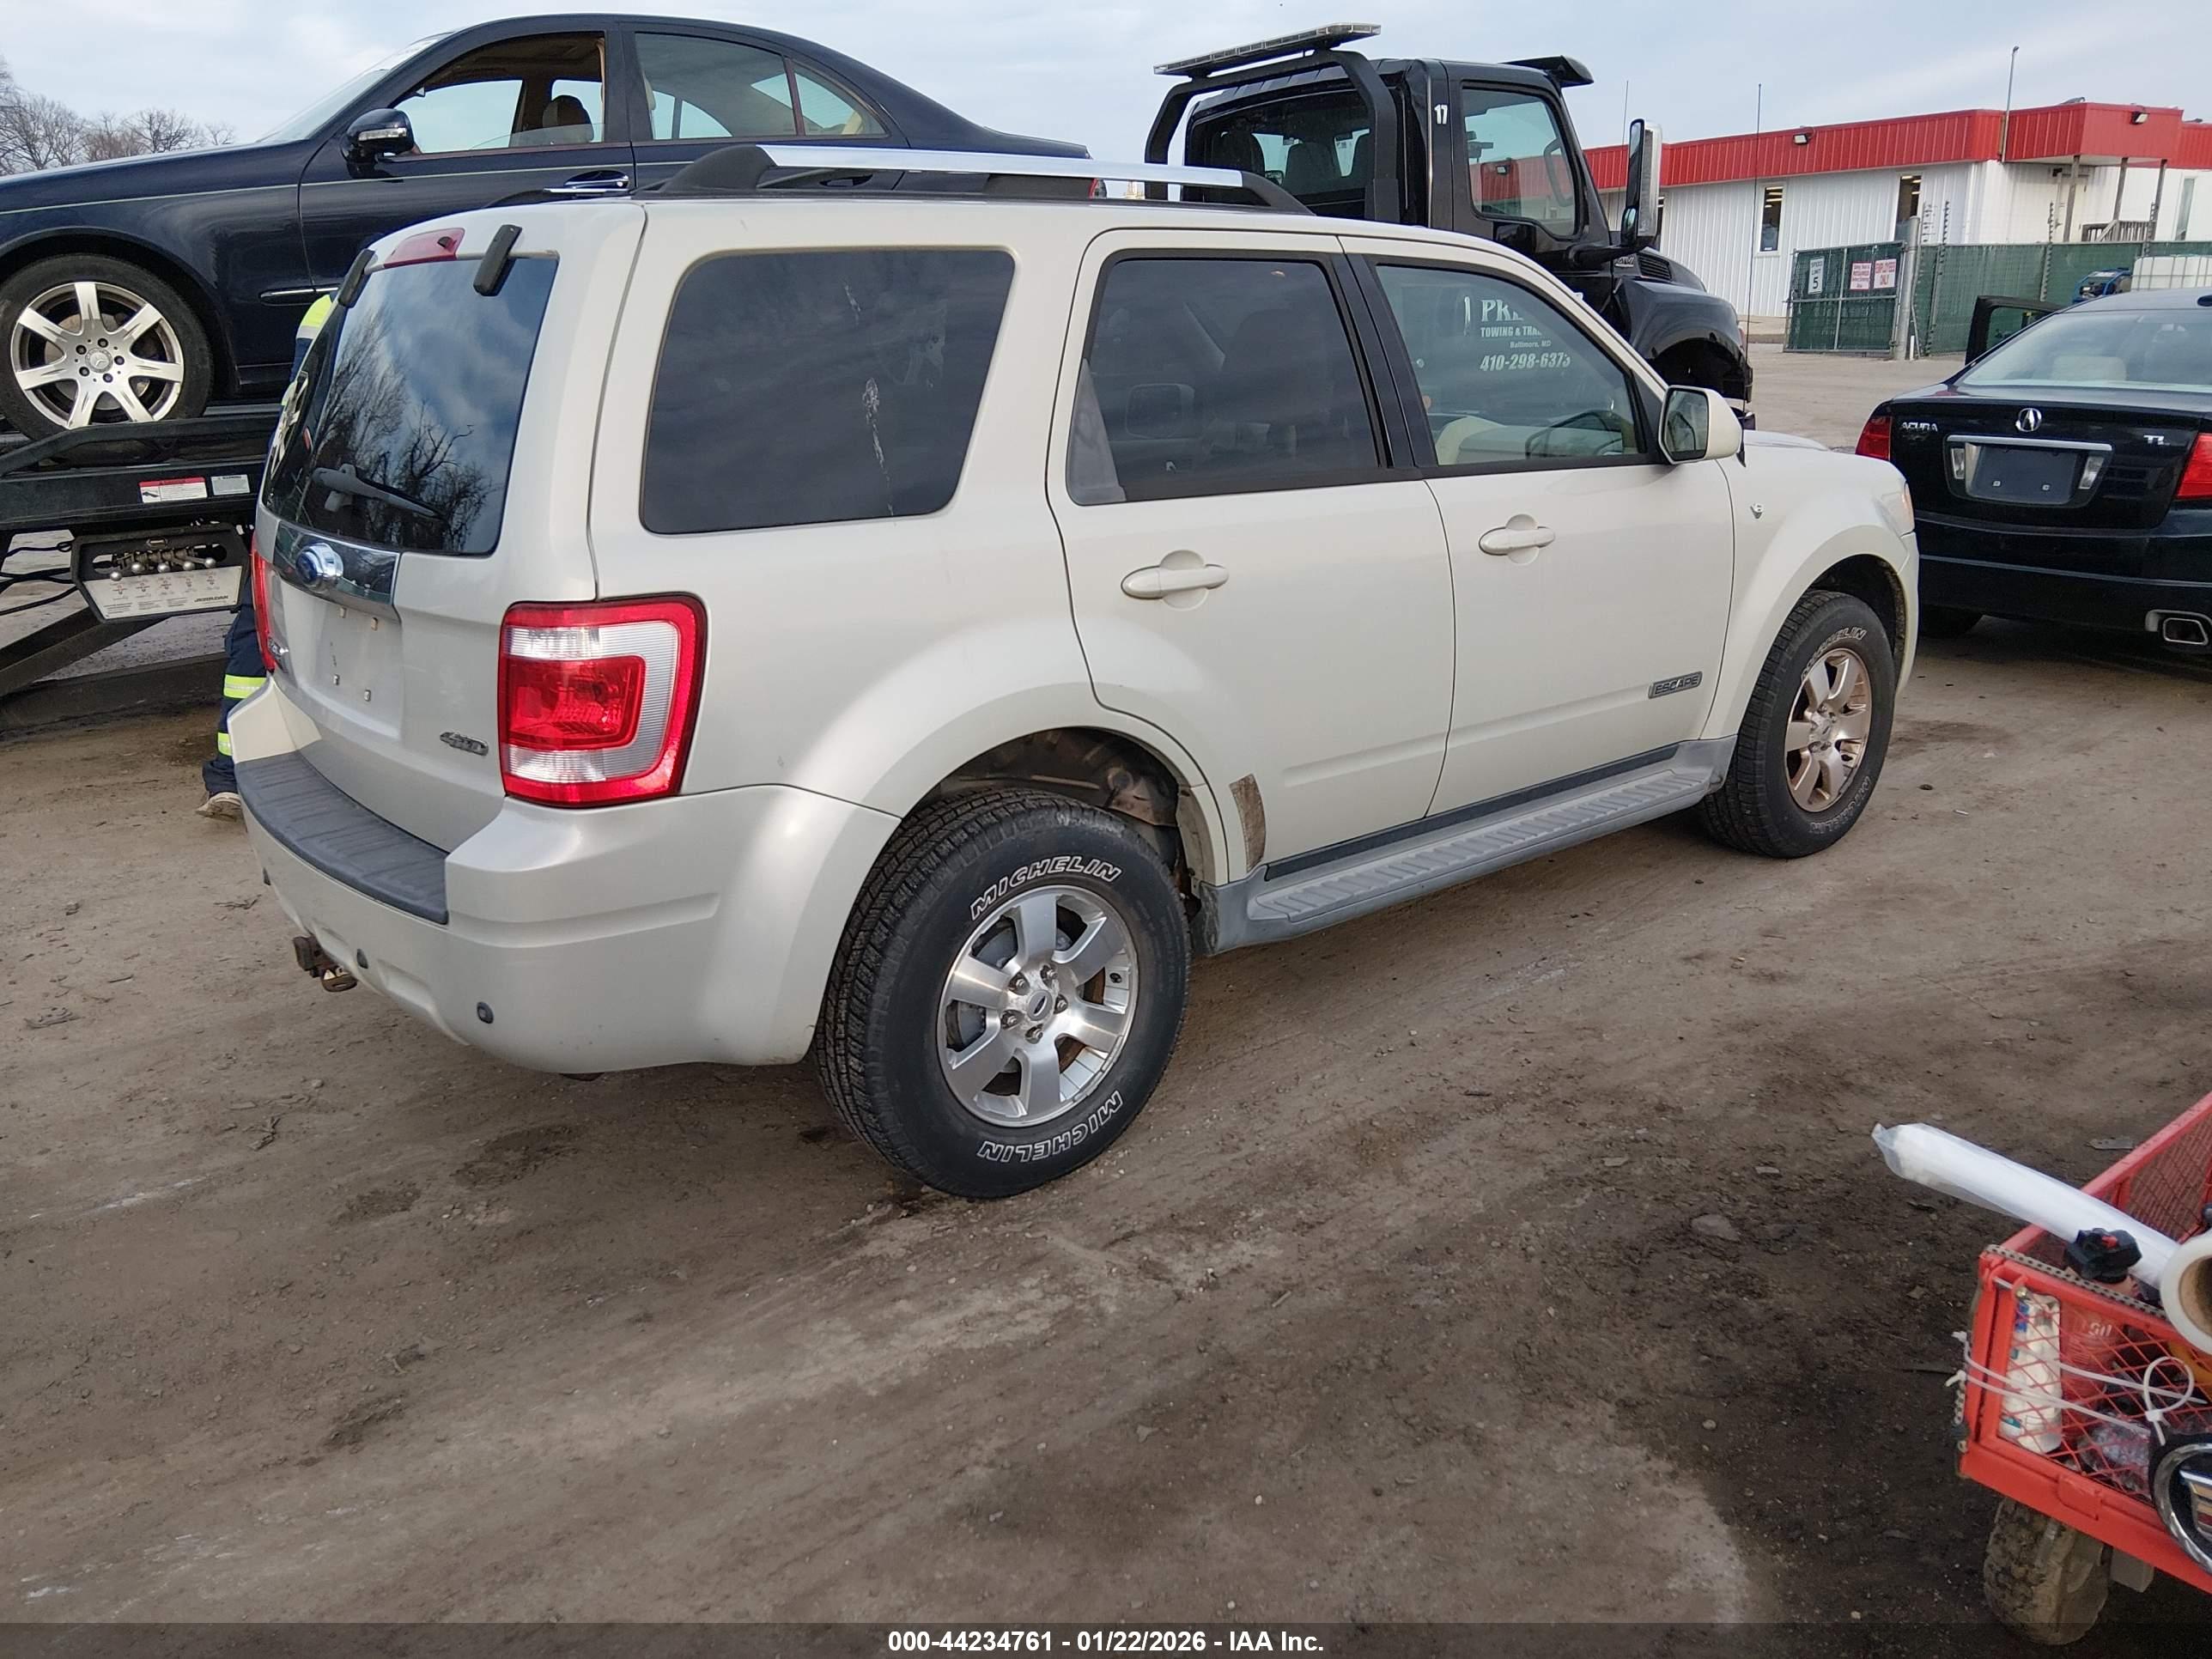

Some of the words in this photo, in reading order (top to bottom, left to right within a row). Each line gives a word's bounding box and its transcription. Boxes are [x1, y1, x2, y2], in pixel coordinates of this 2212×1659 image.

[1434, 104, 1448, 125] 17
[1813, 276, 1819, 289] 5
[1480, 326, 1513, 337] TOWING
[1515, 327, 1521, 336] &
[1902, 422, 1938, 432] ACURA
[2143, 434, 2171, 445] TL
[1654, 674, 1699, 695] ESCAPE
[969, 855, 1122, 921] MICHELIN
[977, 1090, 1123, 1163] MICHELIN
